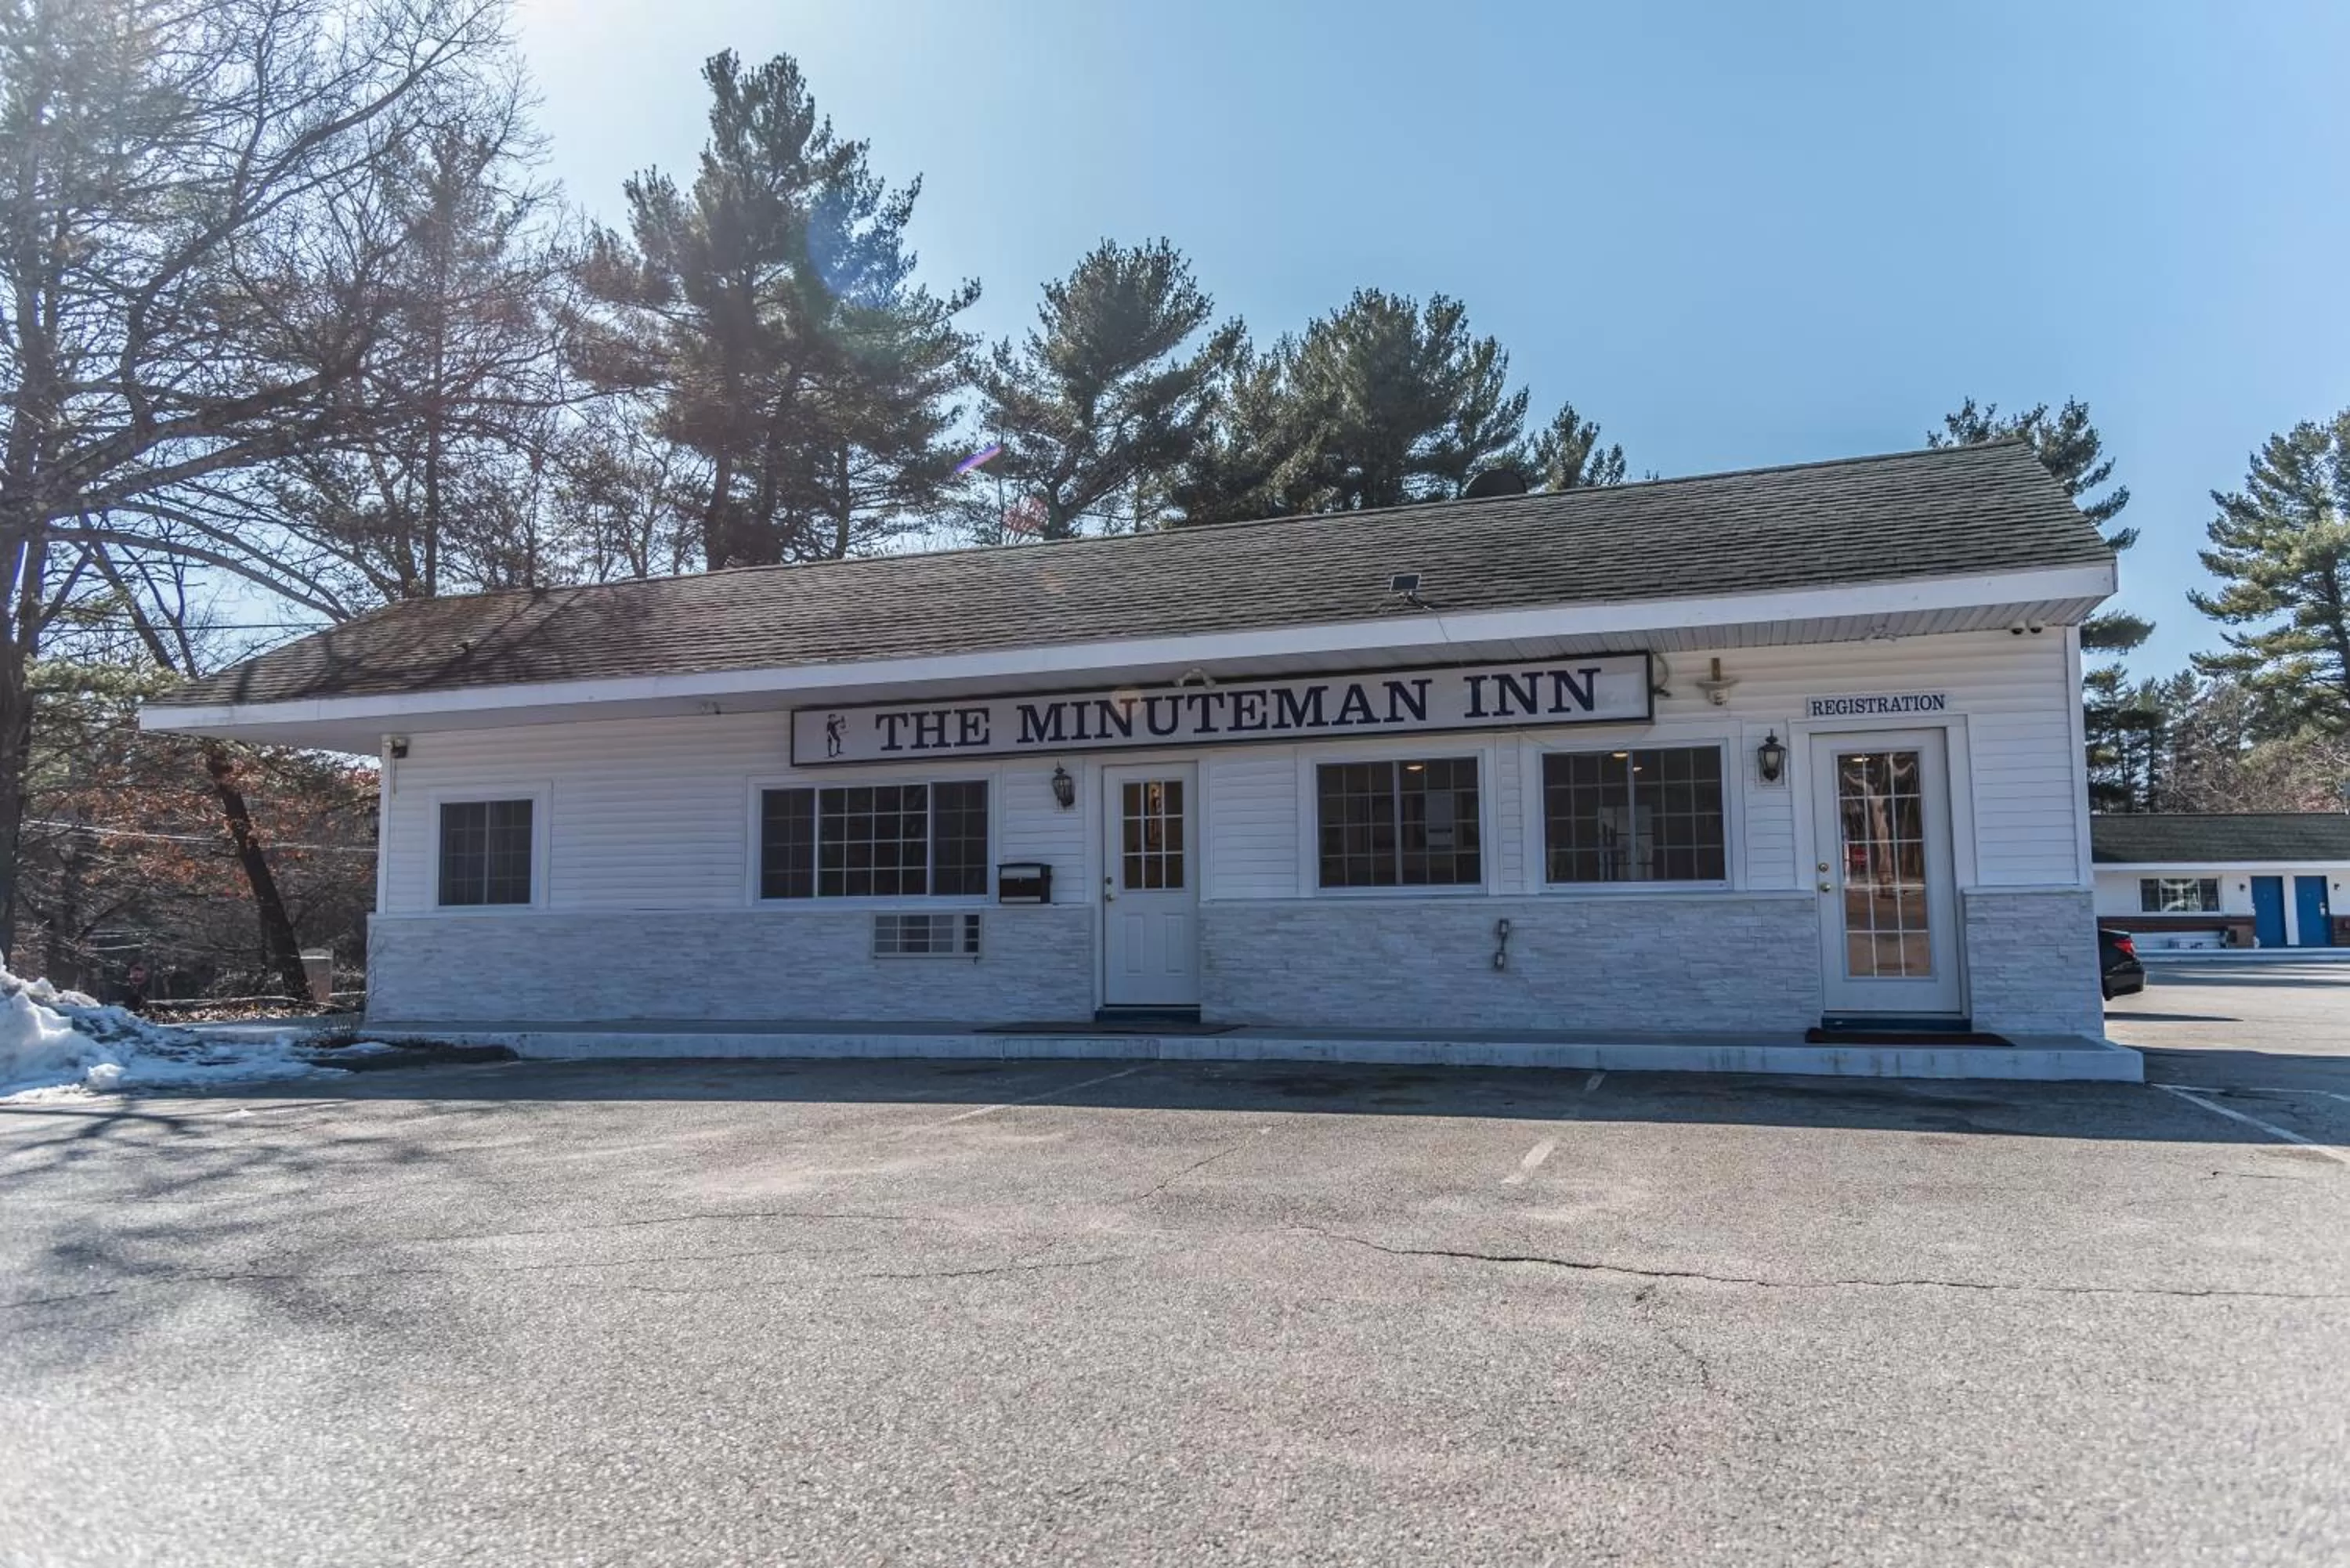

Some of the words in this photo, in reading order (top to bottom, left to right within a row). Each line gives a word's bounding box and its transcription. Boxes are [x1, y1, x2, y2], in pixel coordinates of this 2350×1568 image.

[875, 708, 990, 751] THE
[1016, 678, 1433, 744] MINUTEMAN
[1463, 668, 1601, 718] INN
[1811, 695, 1945, 716] REGISTRATION
